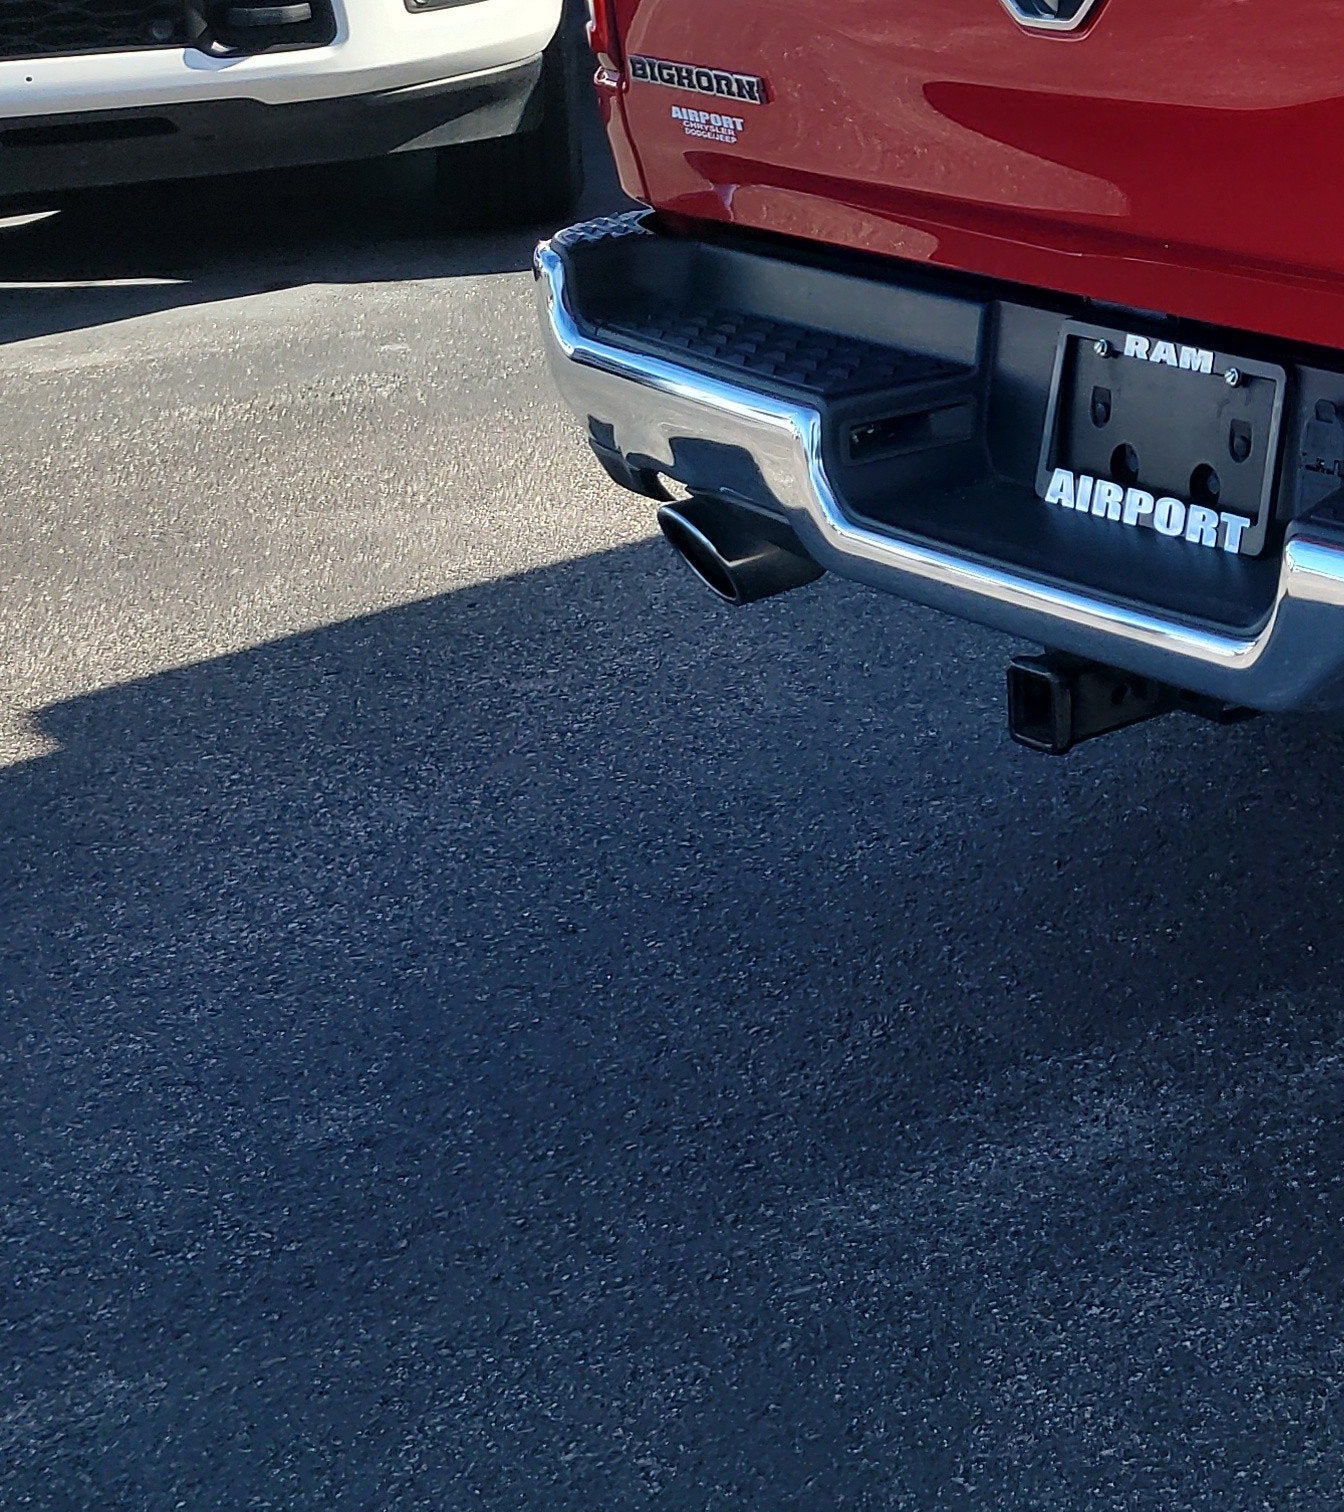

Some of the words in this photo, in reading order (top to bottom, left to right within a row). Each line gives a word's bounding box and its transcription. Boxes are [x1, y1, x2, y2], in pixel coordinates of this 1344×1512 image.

[629, 55, 766, 105] BIGHORN
[671, 105, 744, 131] AIRPORT
[683, 120, 736, 137] CHRYSLER
[1123, 333, 1216, 375] RAM
[1044, 467, 1252, 554] AIRPORT
